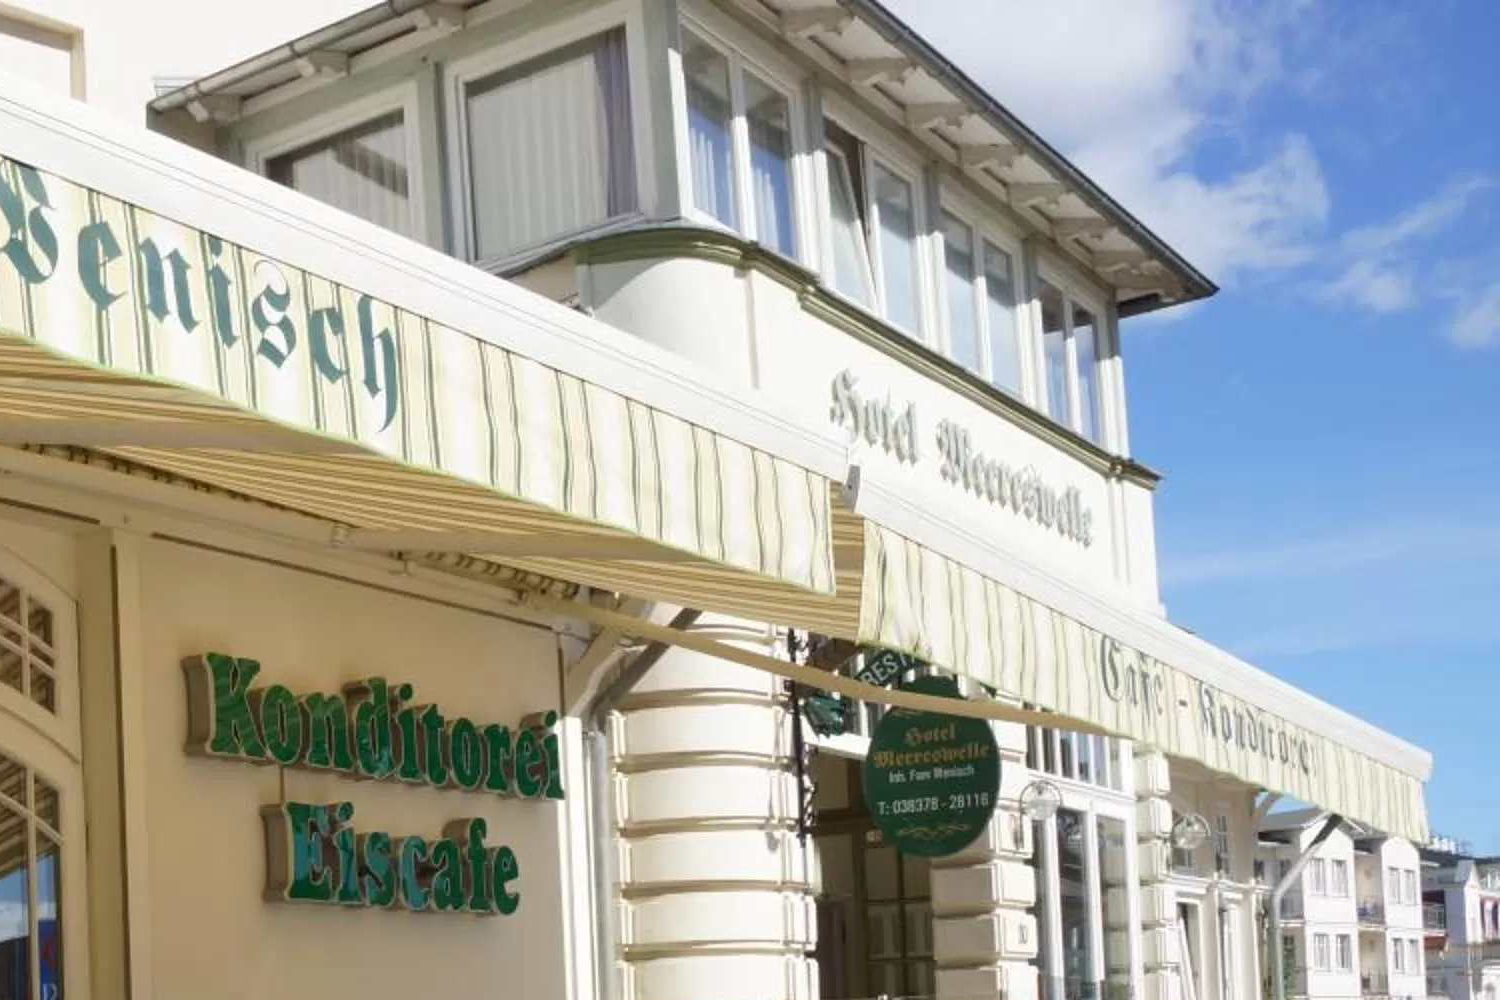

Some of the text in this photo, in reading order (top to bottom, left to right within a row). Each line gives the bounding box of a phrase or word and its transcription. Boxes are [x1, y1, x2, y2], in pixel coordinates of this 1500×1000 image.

[829, 367, 918, 467] Hotel
[200, 651, 566, 801] Konditorei
[905, 723, 956, 747] Hotel
[283, 800, 521, 916] Eiscafe
